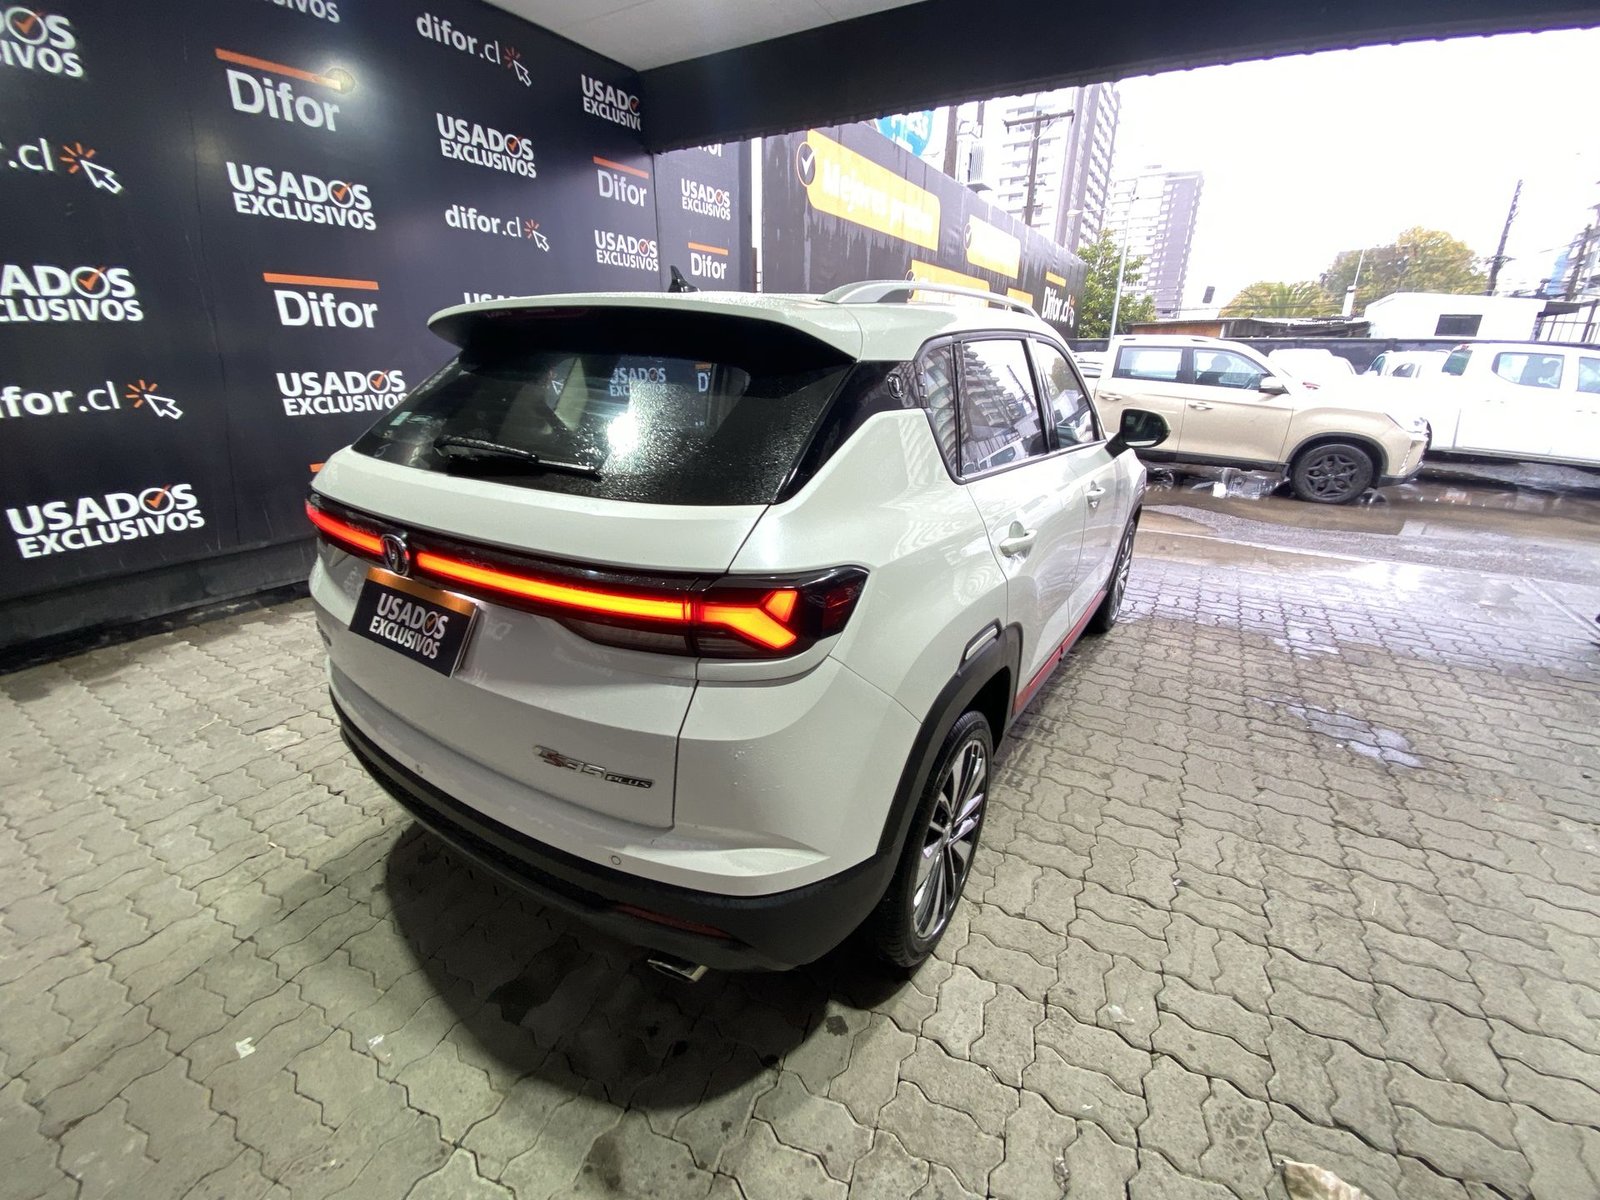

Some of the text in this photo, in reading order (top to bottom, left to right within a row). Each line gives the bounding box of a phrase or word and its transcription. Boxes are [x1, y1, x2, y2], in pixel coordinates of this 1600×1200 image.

[416, 12, 501, 65] difor.cl
[225, 69, 340, 132] Difor
[436, 112, 535, 162] USADOS
[440, 138, 537, 179] EXCLUSIVOS
[226, 161, 372, 210] USADOS
[597, 169, 647, 207] Difor
[681, 178, 731, 208] USADOS
[233, 192, 377, 231] EXCLUSIVOS
[445, 205, 522, 238] difor.cl
[681, 196, 731, 221] EXCLUSIVOS
[594, 229, 658, 259] USADOS
[596, 249, 659, 272] EXCLUSIVOS
[690, 252, 727, 280] Difor
[273, 289, 378, 329] Difor
[0, 380, 121, 419] for.cl
[276, 370, 406, 397] USADOS
[6, 483, 198, 536] USADOS
[16, 509, 206, 559] EXCLUSIVOS
[376, 592, 449, 640] USADOS
[368, 615, 441, 660] EXCLUSIVOS
